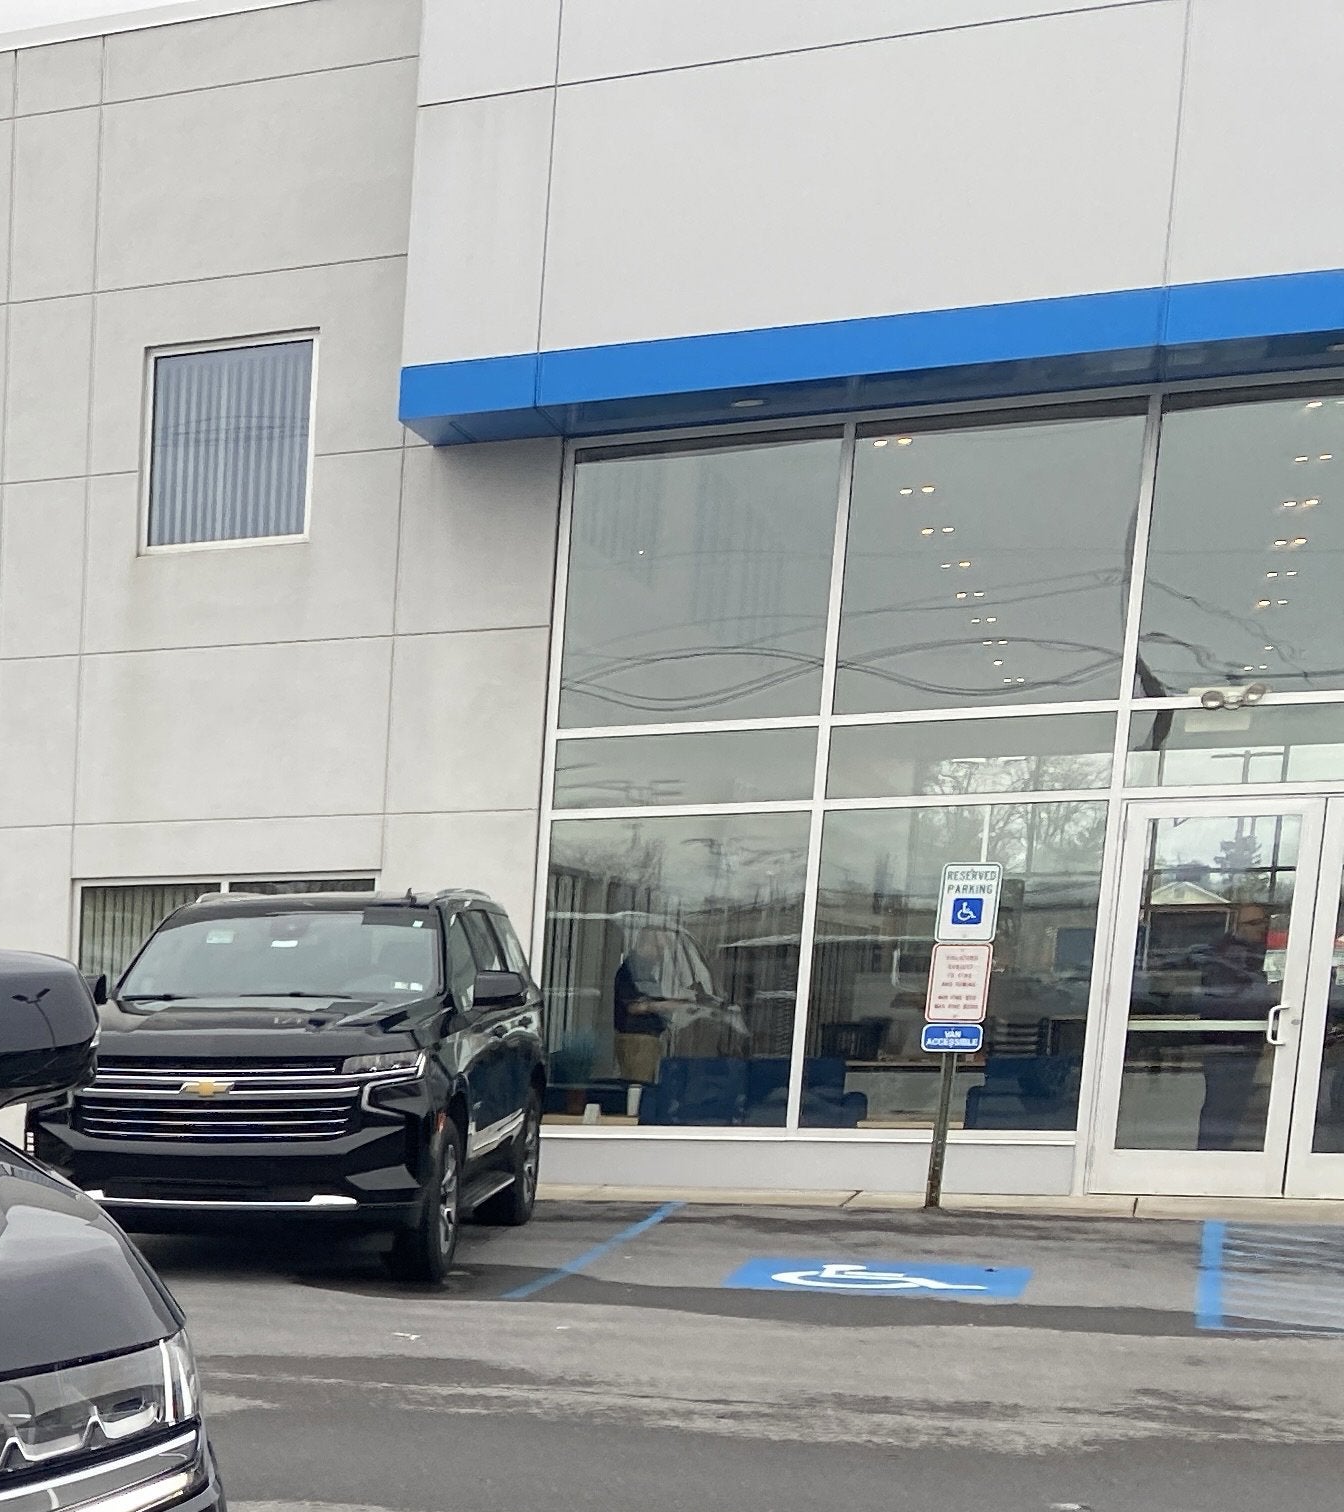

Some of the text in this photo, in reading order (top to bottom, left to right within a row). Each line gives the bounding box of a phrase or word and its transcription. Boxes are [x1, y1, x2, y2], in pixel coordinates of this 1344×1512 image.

[947, 870, 998, 881] RESERVED
[947, 884, 993, 895] PARKING
[944, 1030, 962, 1038] VAN
[925, 1037, 979, 1047] ACCESSIBLE
